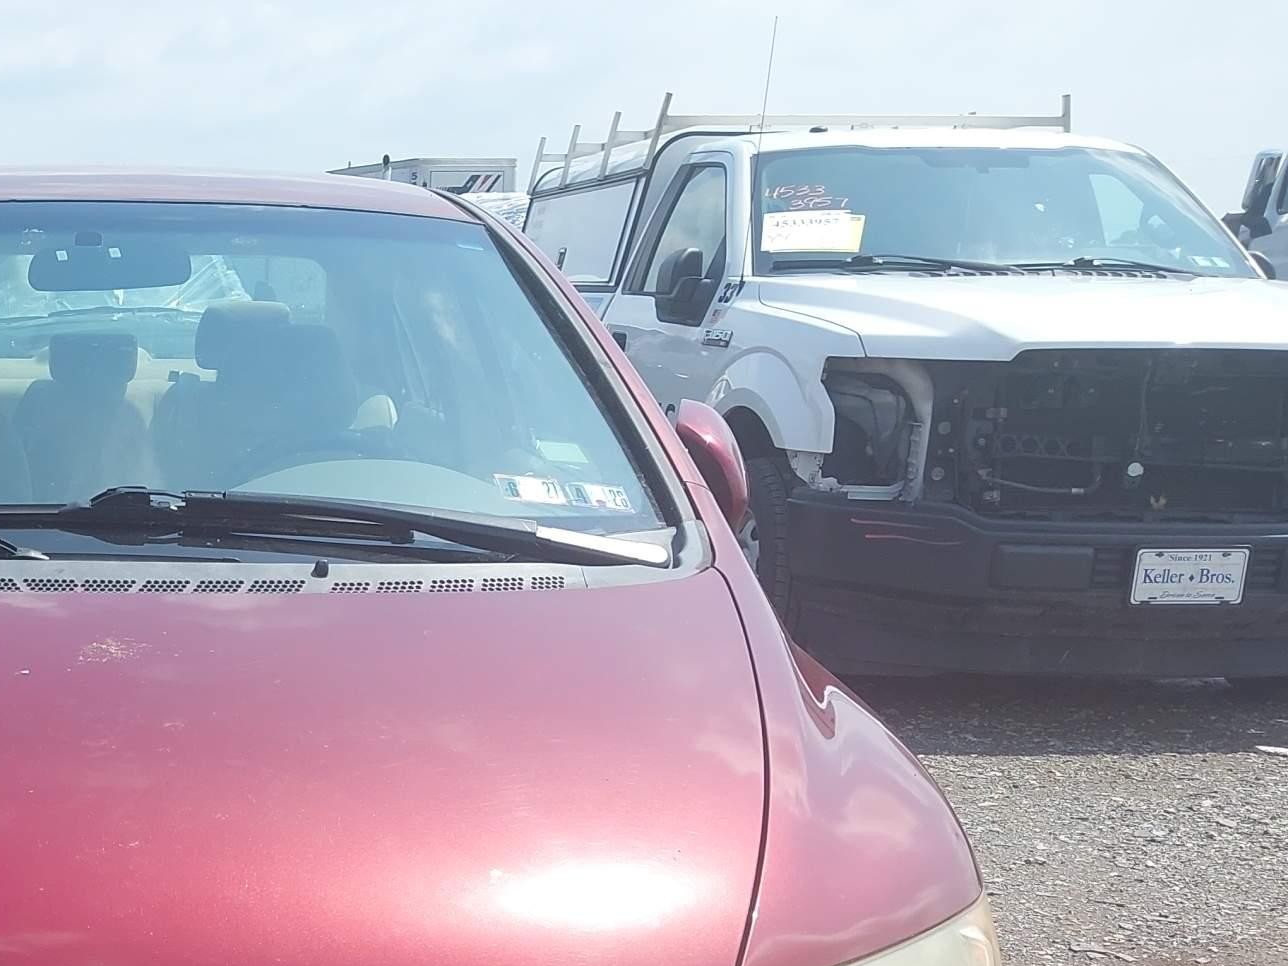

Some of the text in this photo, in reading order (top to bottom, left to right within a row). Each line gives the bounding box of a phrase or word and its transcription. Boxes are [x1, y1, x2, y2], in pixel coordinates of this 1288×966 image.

[765, 185, 825, 199] 4533
[1169, 553, 1213, 562] Since 1921
[1142, 568, 1234, 584] Keller Bros.
